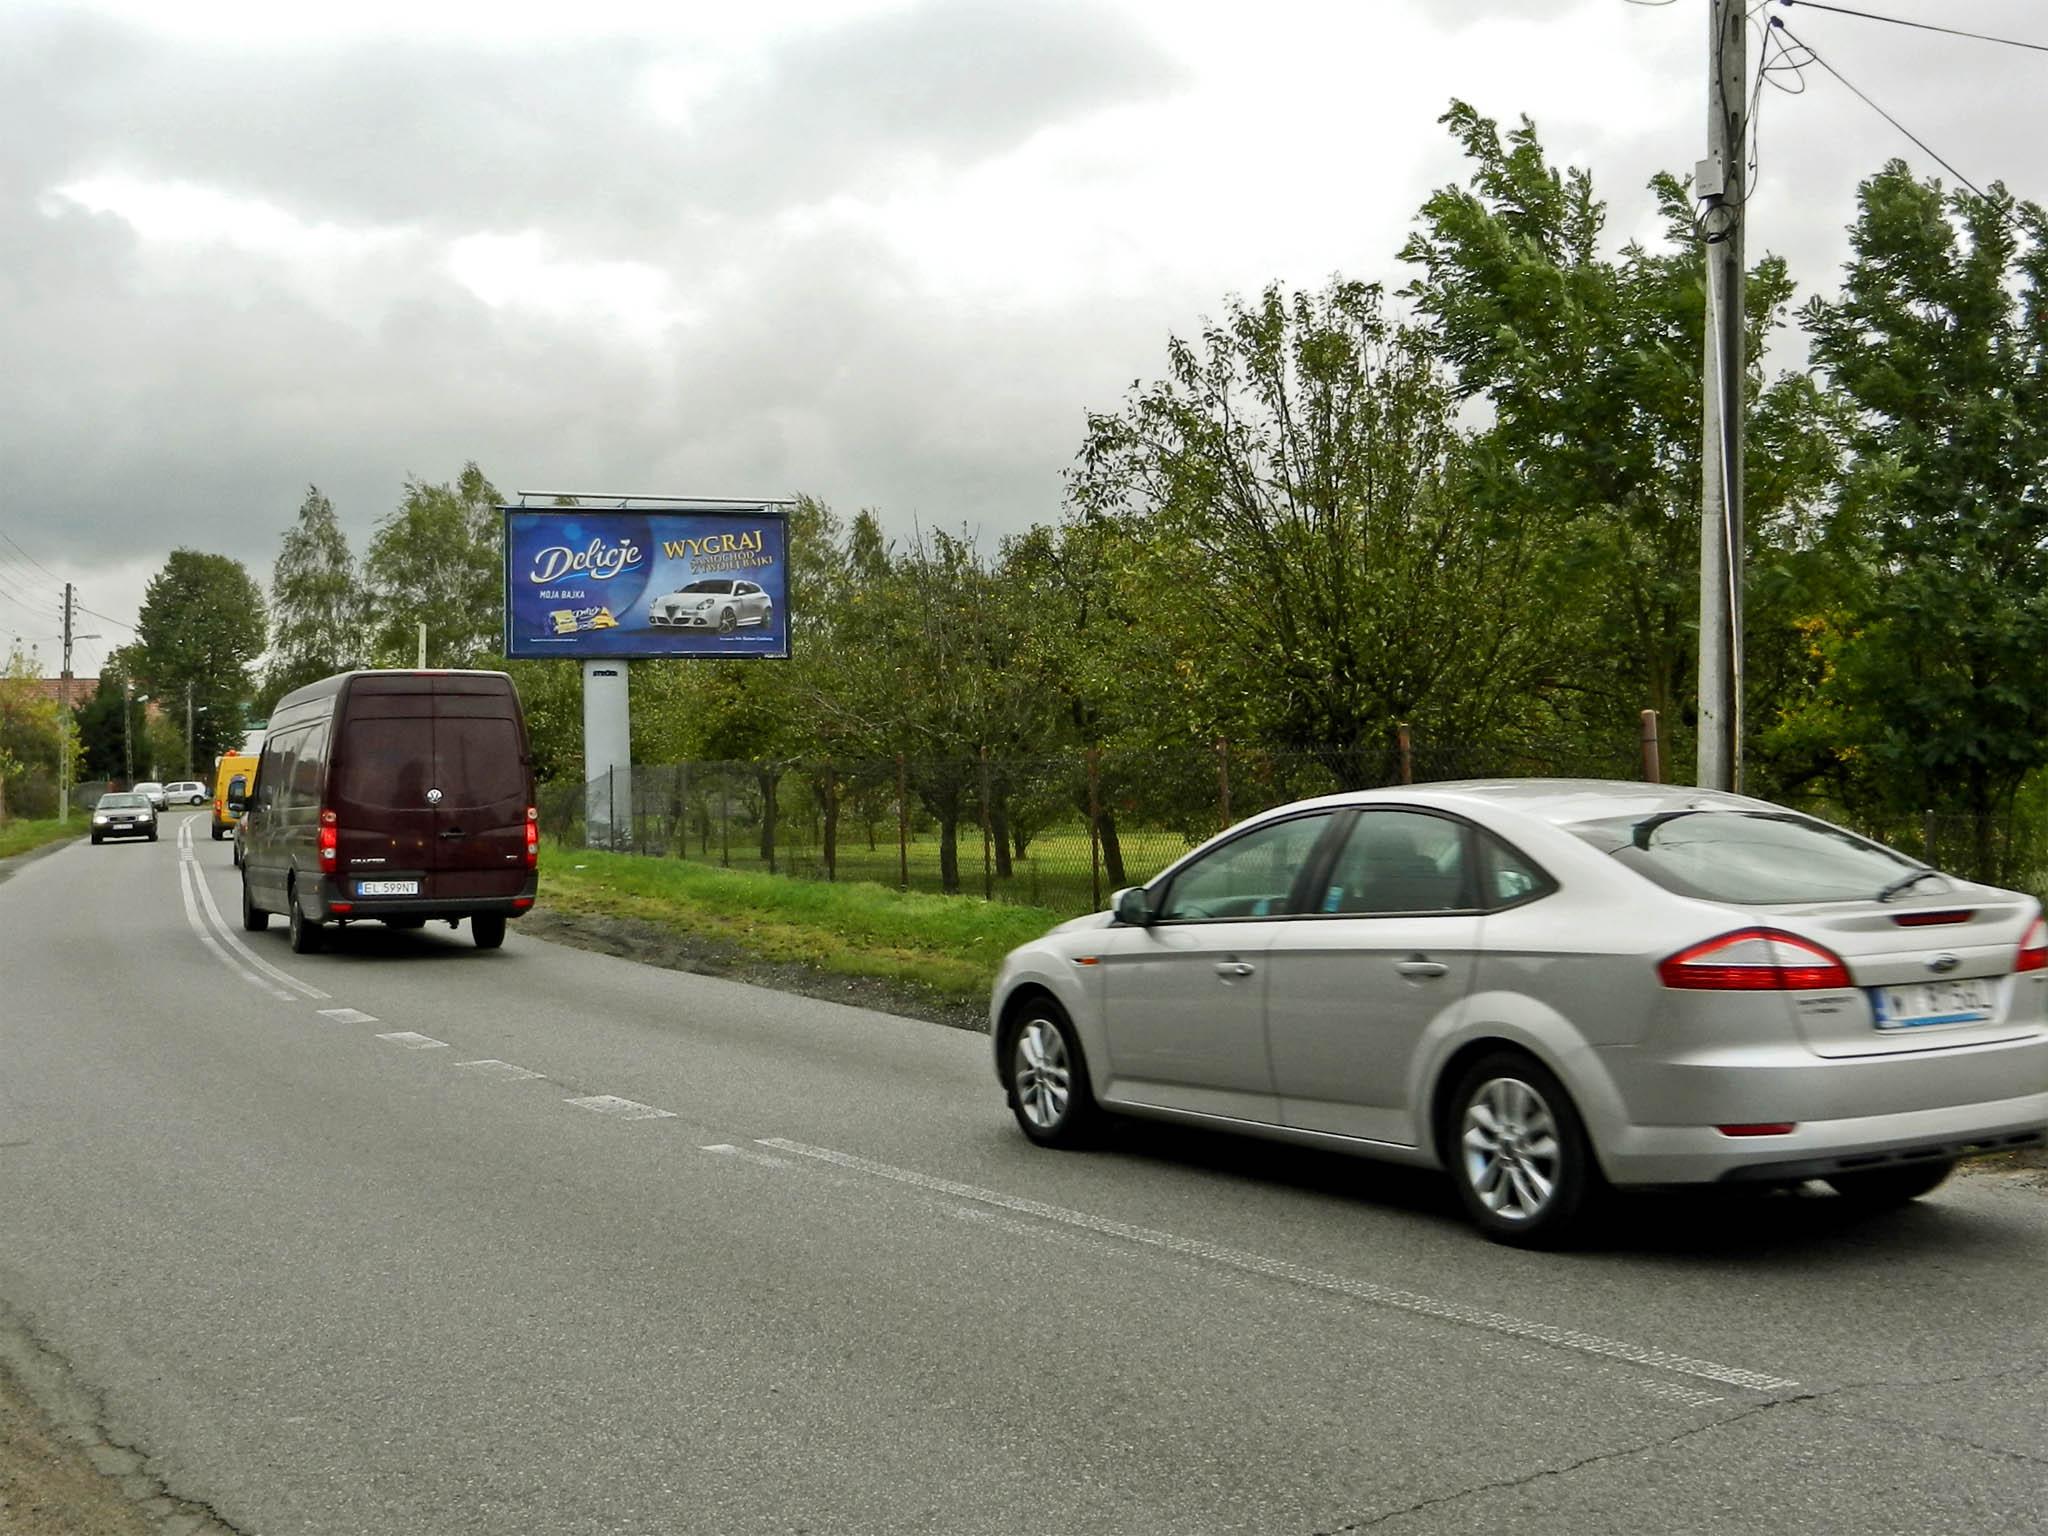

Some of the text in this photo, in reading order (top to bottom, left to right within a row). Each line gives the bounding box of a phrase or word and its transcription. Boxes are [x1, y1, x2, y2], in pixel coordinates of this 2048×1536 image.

[663, 530, 763, 560] WYGRAJ
[530, 537, 642, 584] Delicje
[540, 590, 585, 599] MOJA BAJKA
[364, 882, 416, 893] EL 599NT
